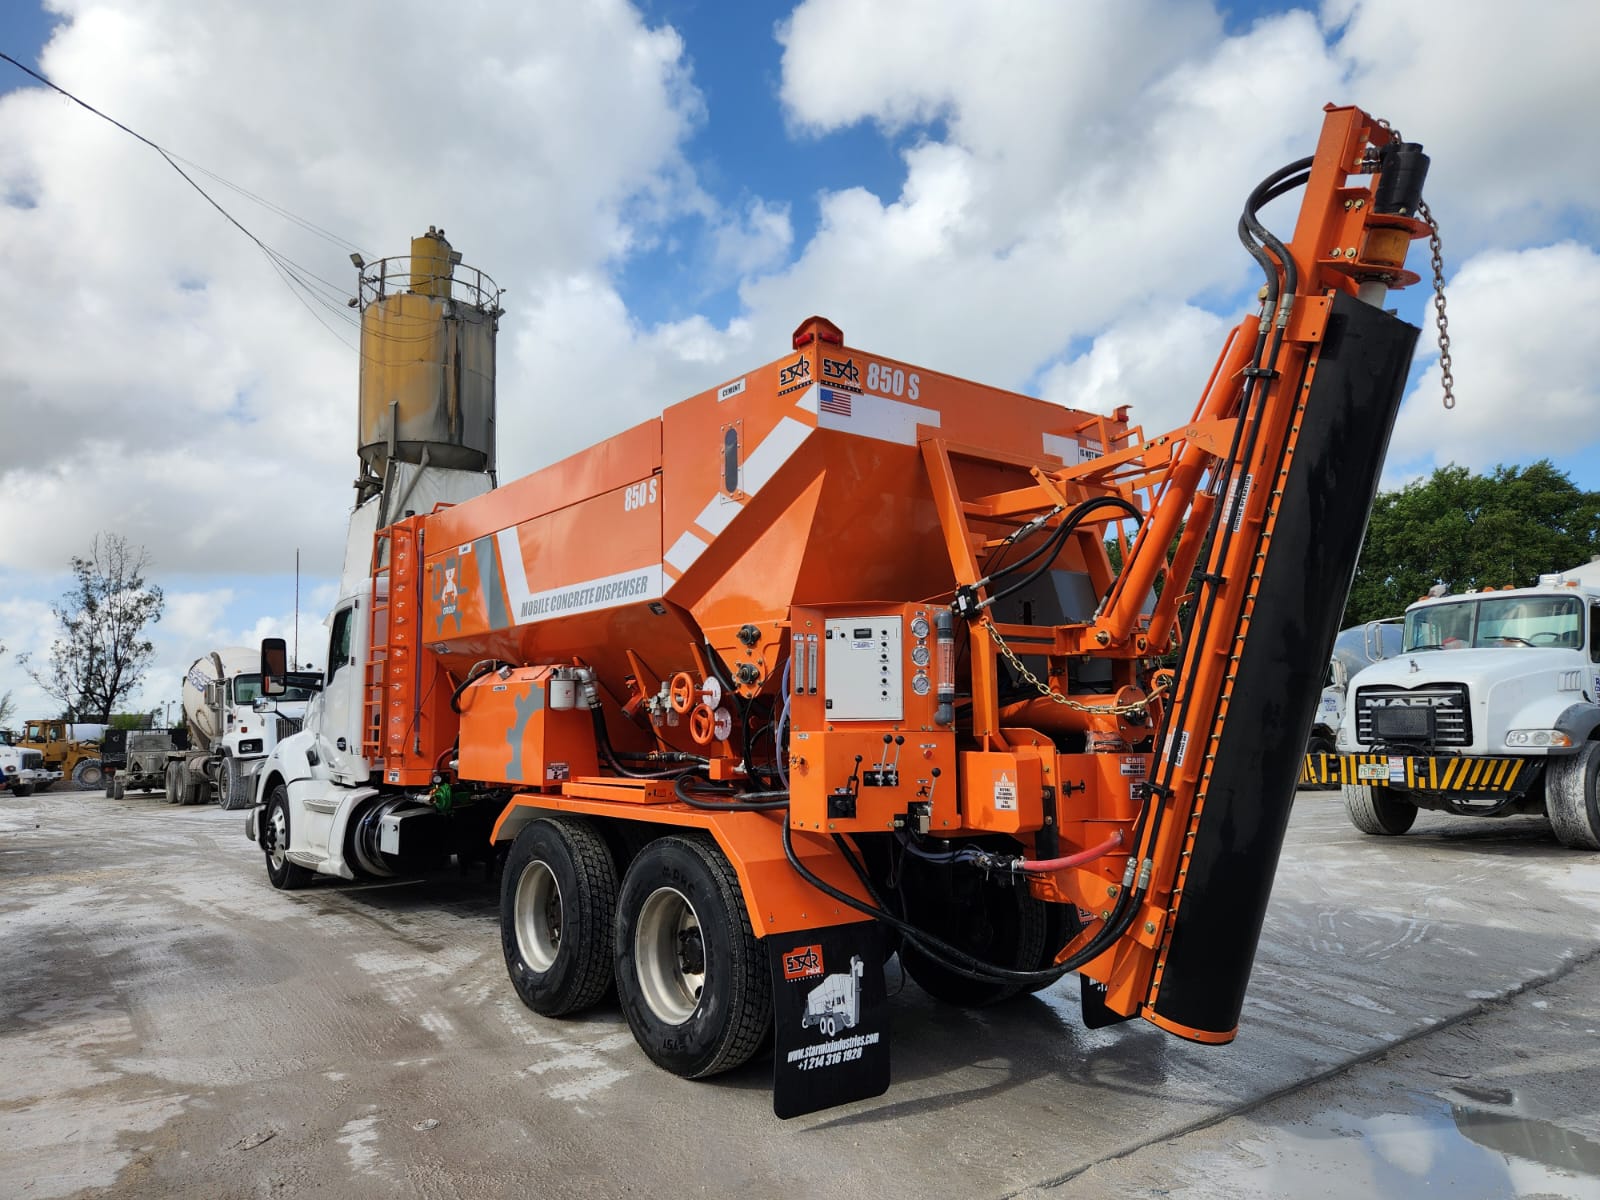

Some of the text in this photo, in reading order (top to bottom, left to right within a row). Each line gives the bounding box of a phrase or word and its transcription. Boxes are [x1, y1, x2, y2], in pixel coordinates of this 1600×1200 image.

[780, 354, 810, 386] STAR
[823, 358, 859, 383] STAR
[866, 362, 905, 397] 850
[908, 373, 920, 400] S
[624, 478, 657, 512] 850 S
[521, 575, 649, 618] MOBILE CONCRETE DISPENSER
[1365, 697, 1454, 707] MACK
[786, 947, 819, 972] STAR
[798, 1059, 808, 1071] +1
[808, 1055, 825, 1070] 214
[825, 1051, 842, 1066] 316
